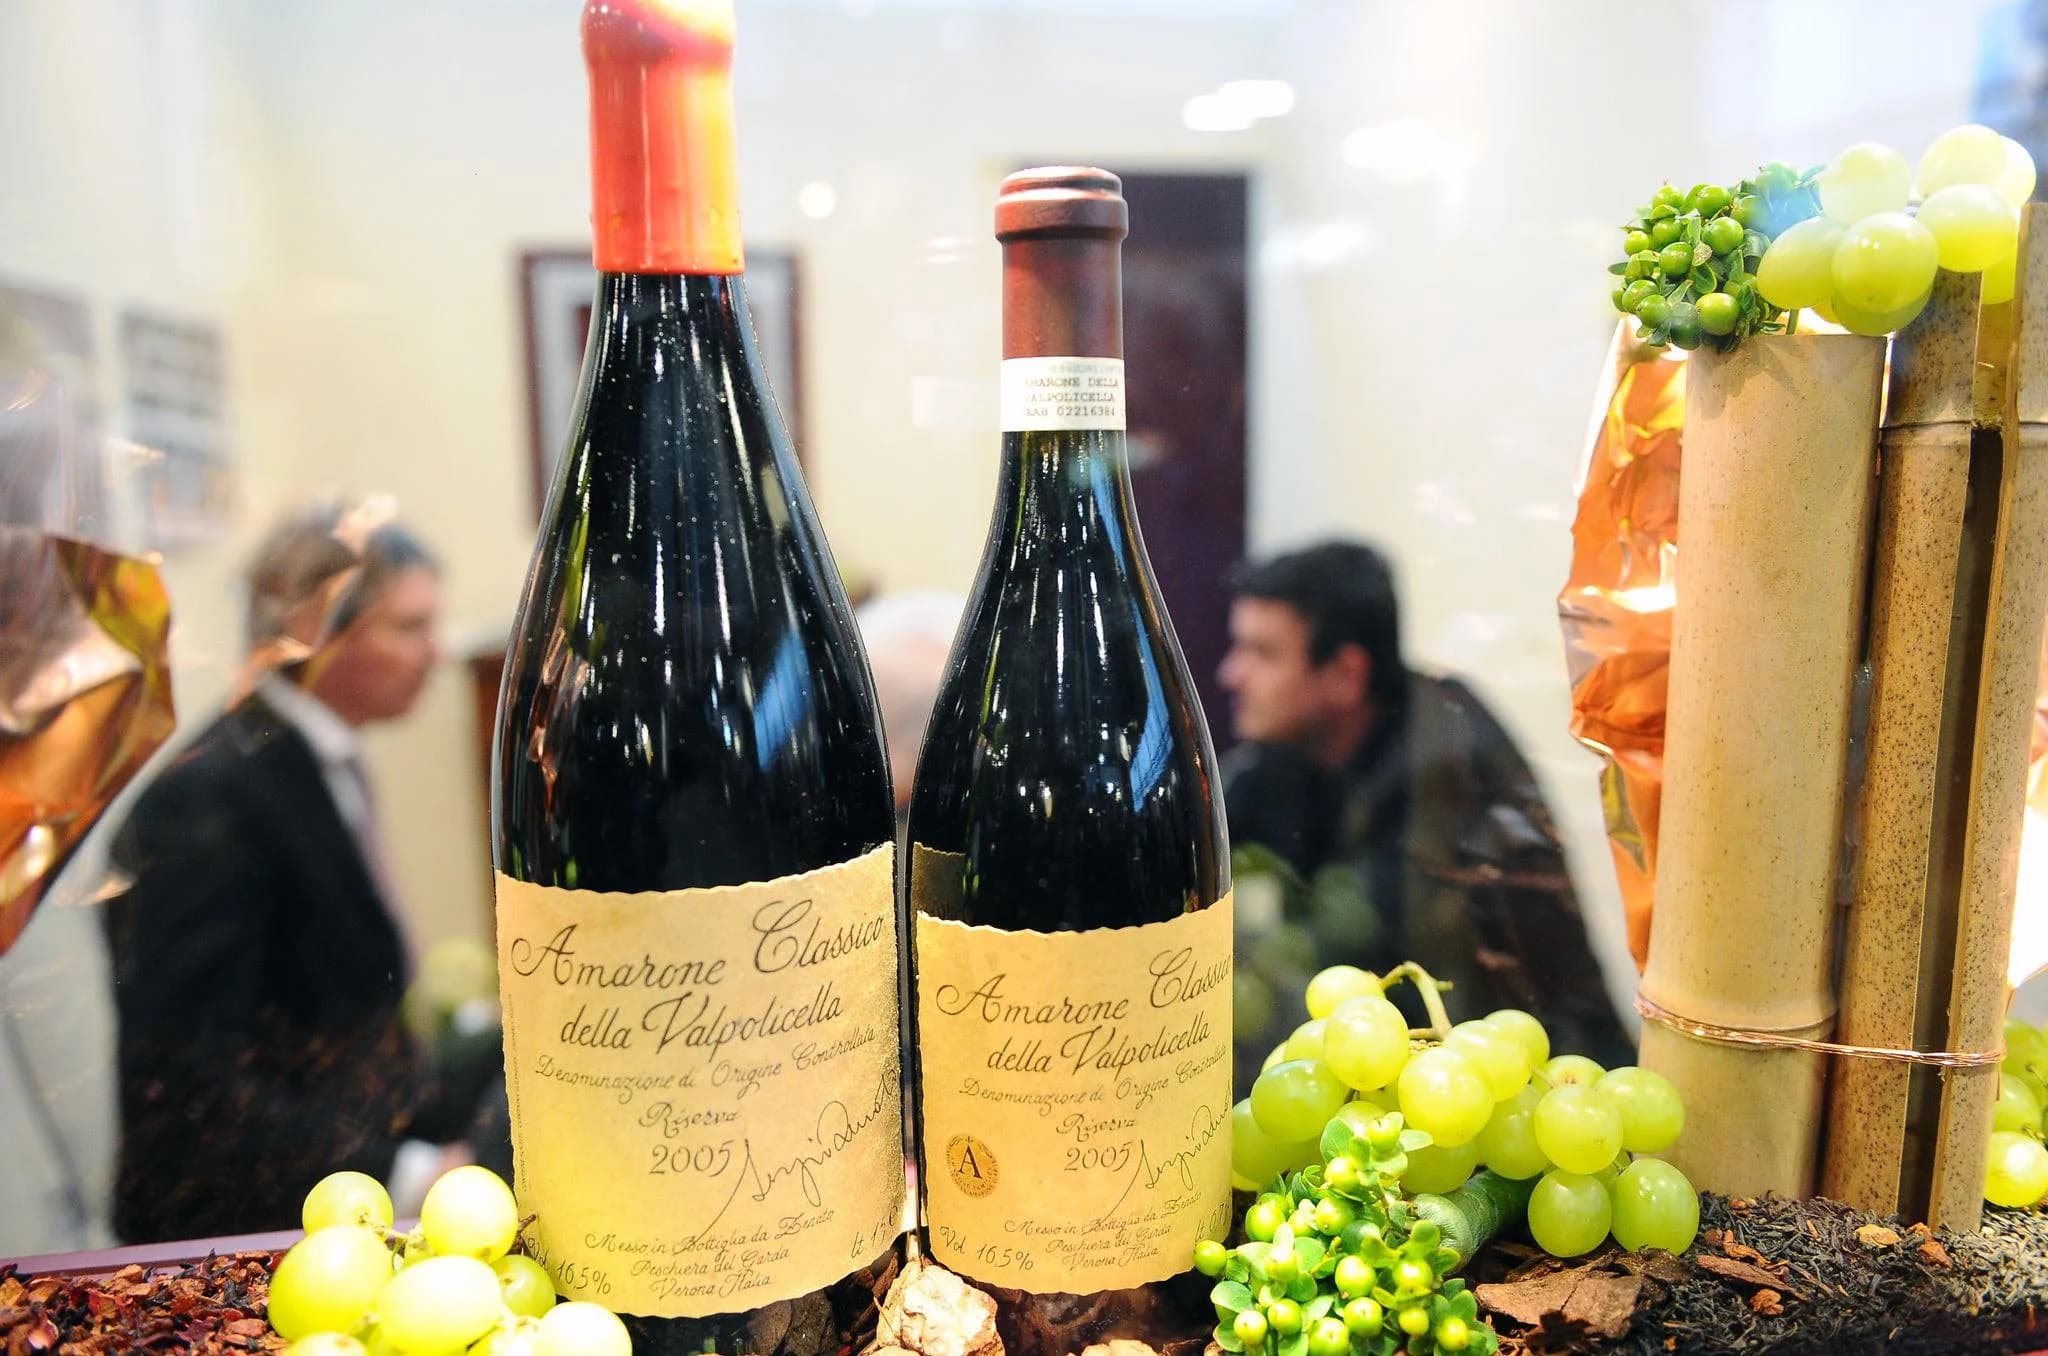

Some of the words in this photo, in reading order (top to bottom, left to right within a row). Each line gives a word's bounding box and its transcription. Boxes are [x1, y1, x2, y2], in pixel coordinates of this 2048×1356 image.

[511, 923, 725, 988] Amarone
[752, 899, 885, 974] Classico
[936, 973, 1130, 1025] Amarone
[560, 1002, 631, 1048] della
[641, 981, 843, 1062] Valpolicella
[987, 1035, 1052, 1073] della
[1060, 1010, 1211, 1081] Valpolicella
[536, 1055, 674, 1104] Denominazione
[678, 1073, 696, 1089] di
[711, 1060, 783, 1099] Origine
[792, 1024, 875, 1071] Controllata
[959, 1077, 1085, 1117] Denominazione
[1116, 1077, 1170, 1110] Origine
[639, 1102, 742, 1139] Riserva
[1056, 1113, 1139, 1143] Riserva
[649, 1140, 736, 1178] 2005
[957, 1144, 983, 1180] A
[1064, 1140, 1133, 1172] 2005
[584, 1232, 648, 1254] Messo
[650, 1241, 666, 1254] in
[672, 1229, 747, 1263] Bottiglia
[750, 1225, 769, 1244] da
[774, 1208, 835, 1240] Zenato
[939, 1225, 966, 1255] Vol
[1004, 1219, 1062, 1236] Messo
[1063, 1225, 1077, 1235] in
[1081, 1215, 1141, 1240] Bottiglia
[1144, 1207, 1158, 1223] da
[1045, 1239, 1112, 1254] Peschiera
[1115, 1234, 1131, 1248] del
[1136, 1222, 1173, 1242] Garda
[630, 1259, 708, 1277] Peschiera
[714, 1255, 733, 1273] del
[741, 1248, 790, 1268] Garda
[1062, 1252, 1116, 1272] Verona
[1118, 1244, 1160, 1268] Italia
[649, 1277, 715, 1300] Verona
[719, 1269, 773, 1297] Italia
